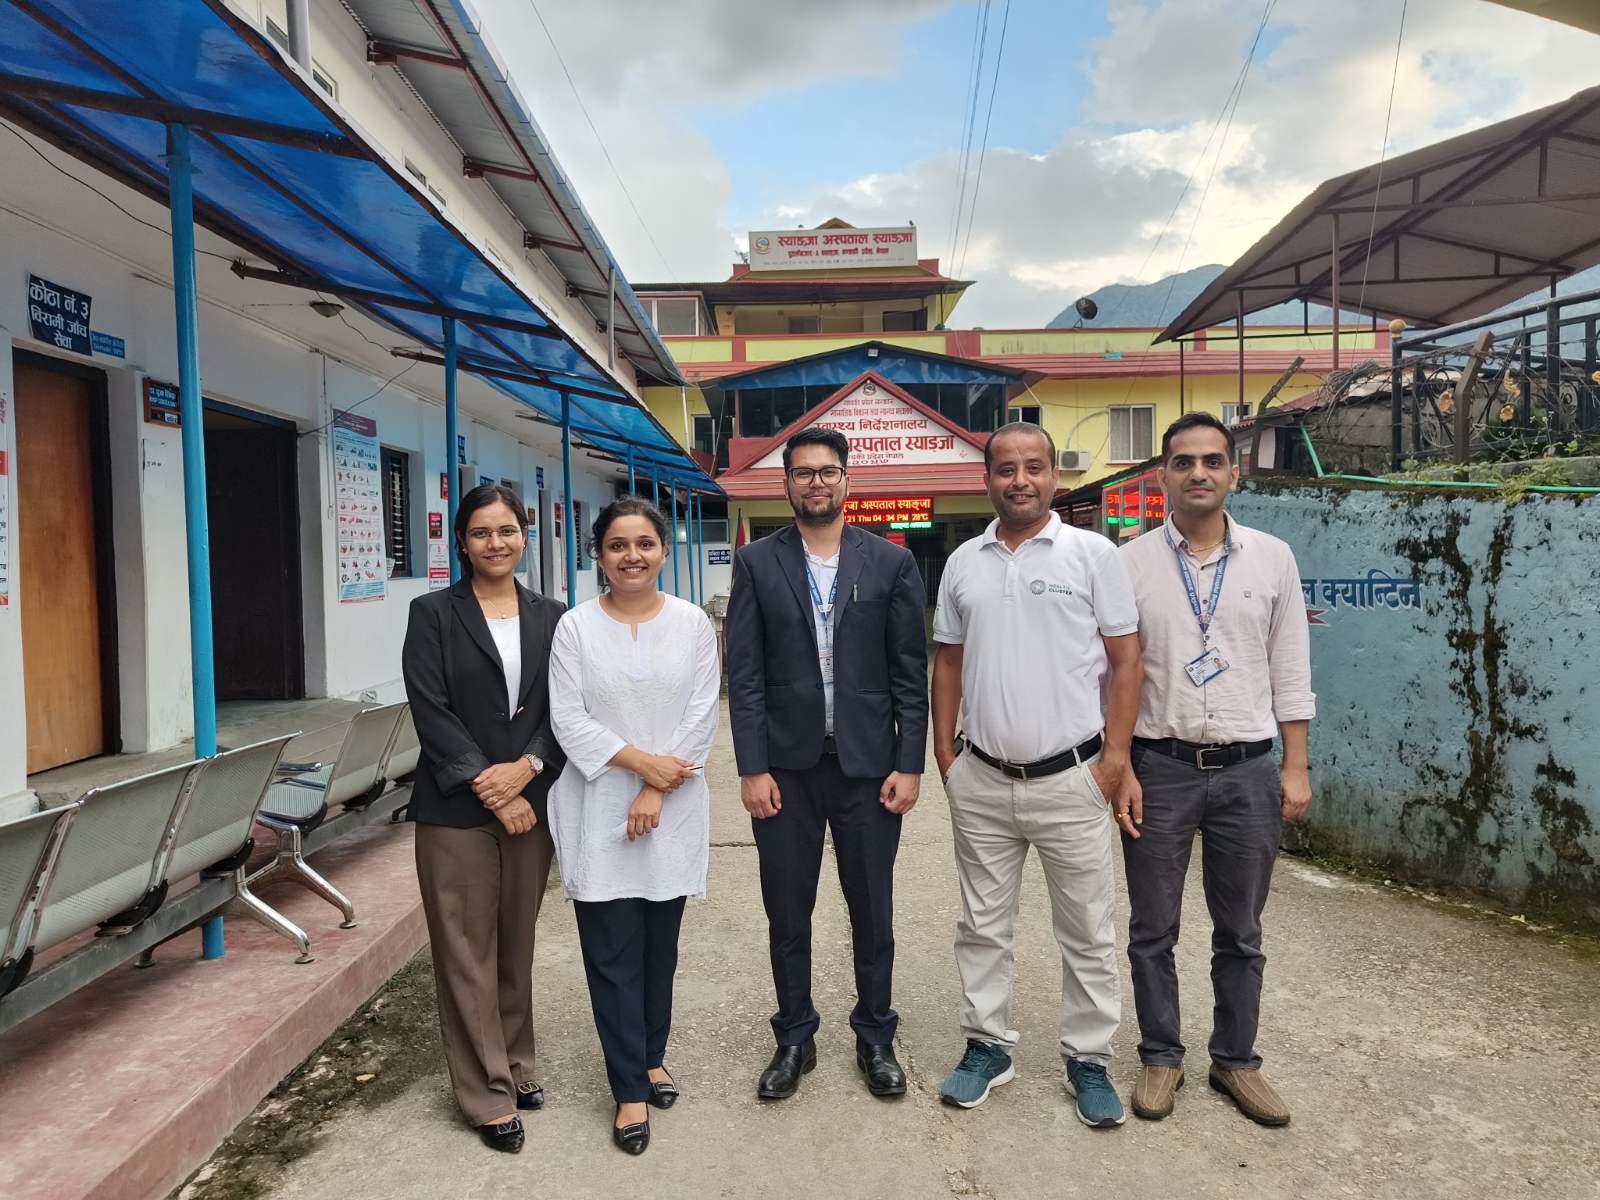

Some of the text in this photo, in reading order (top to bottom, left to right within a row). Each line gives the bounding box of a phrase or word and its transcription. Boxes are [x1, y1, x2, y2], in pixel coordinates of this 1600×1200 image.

[30, 280, 60, 308] कोठा
[80, 302, 89, 319] ३
[54, 330, 72, 349] सेवा
[859, 418, 928, 431] निर्देशनालय
[848, 436, 954, 452] स्पताल स्याङ्जा
[860, 500, 895, 510] अस्पताल
[897, 513, 909, 521] PM
